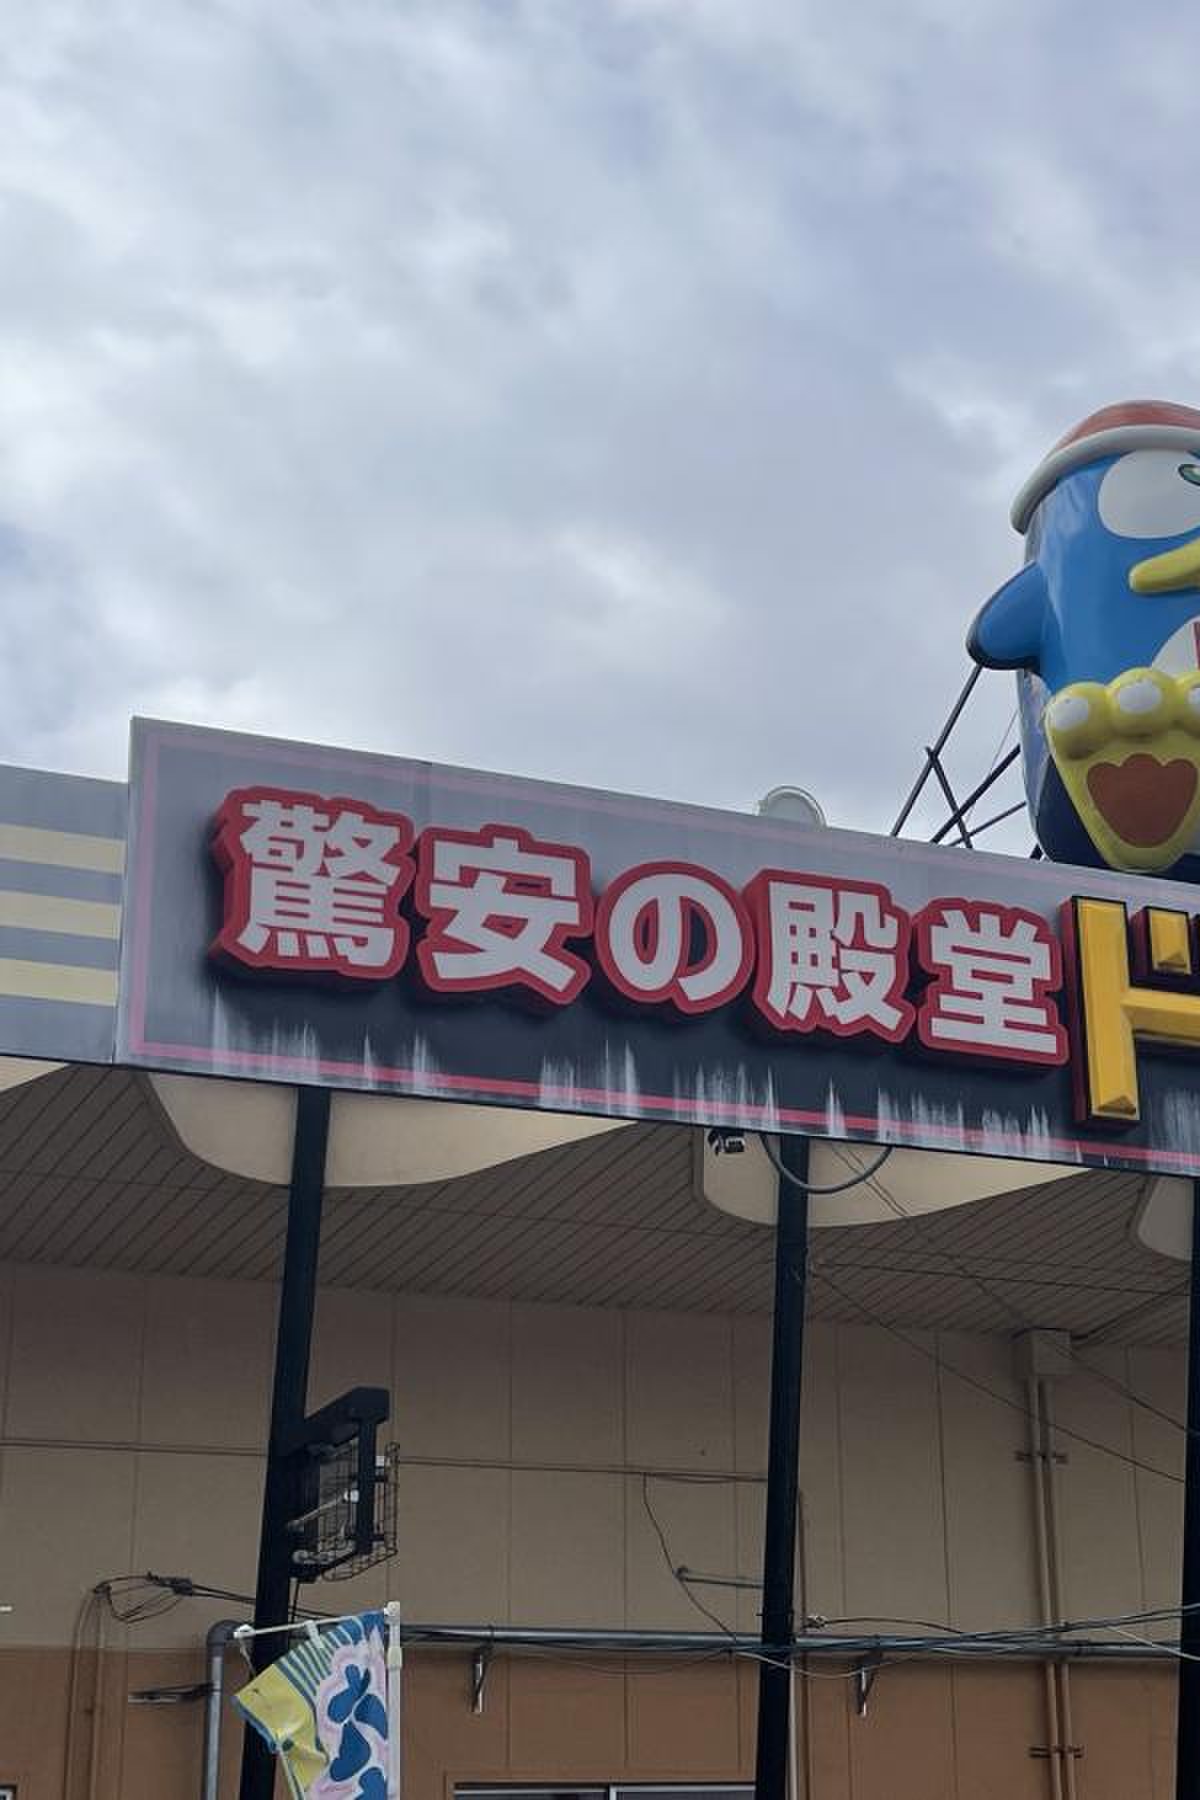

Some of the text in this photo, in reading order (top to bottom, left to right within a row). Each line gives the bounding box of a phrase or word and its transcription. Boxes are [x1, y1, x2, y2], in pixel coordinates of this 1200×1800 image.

[222, 788, 1068, 1065] 驚安の殿堂
